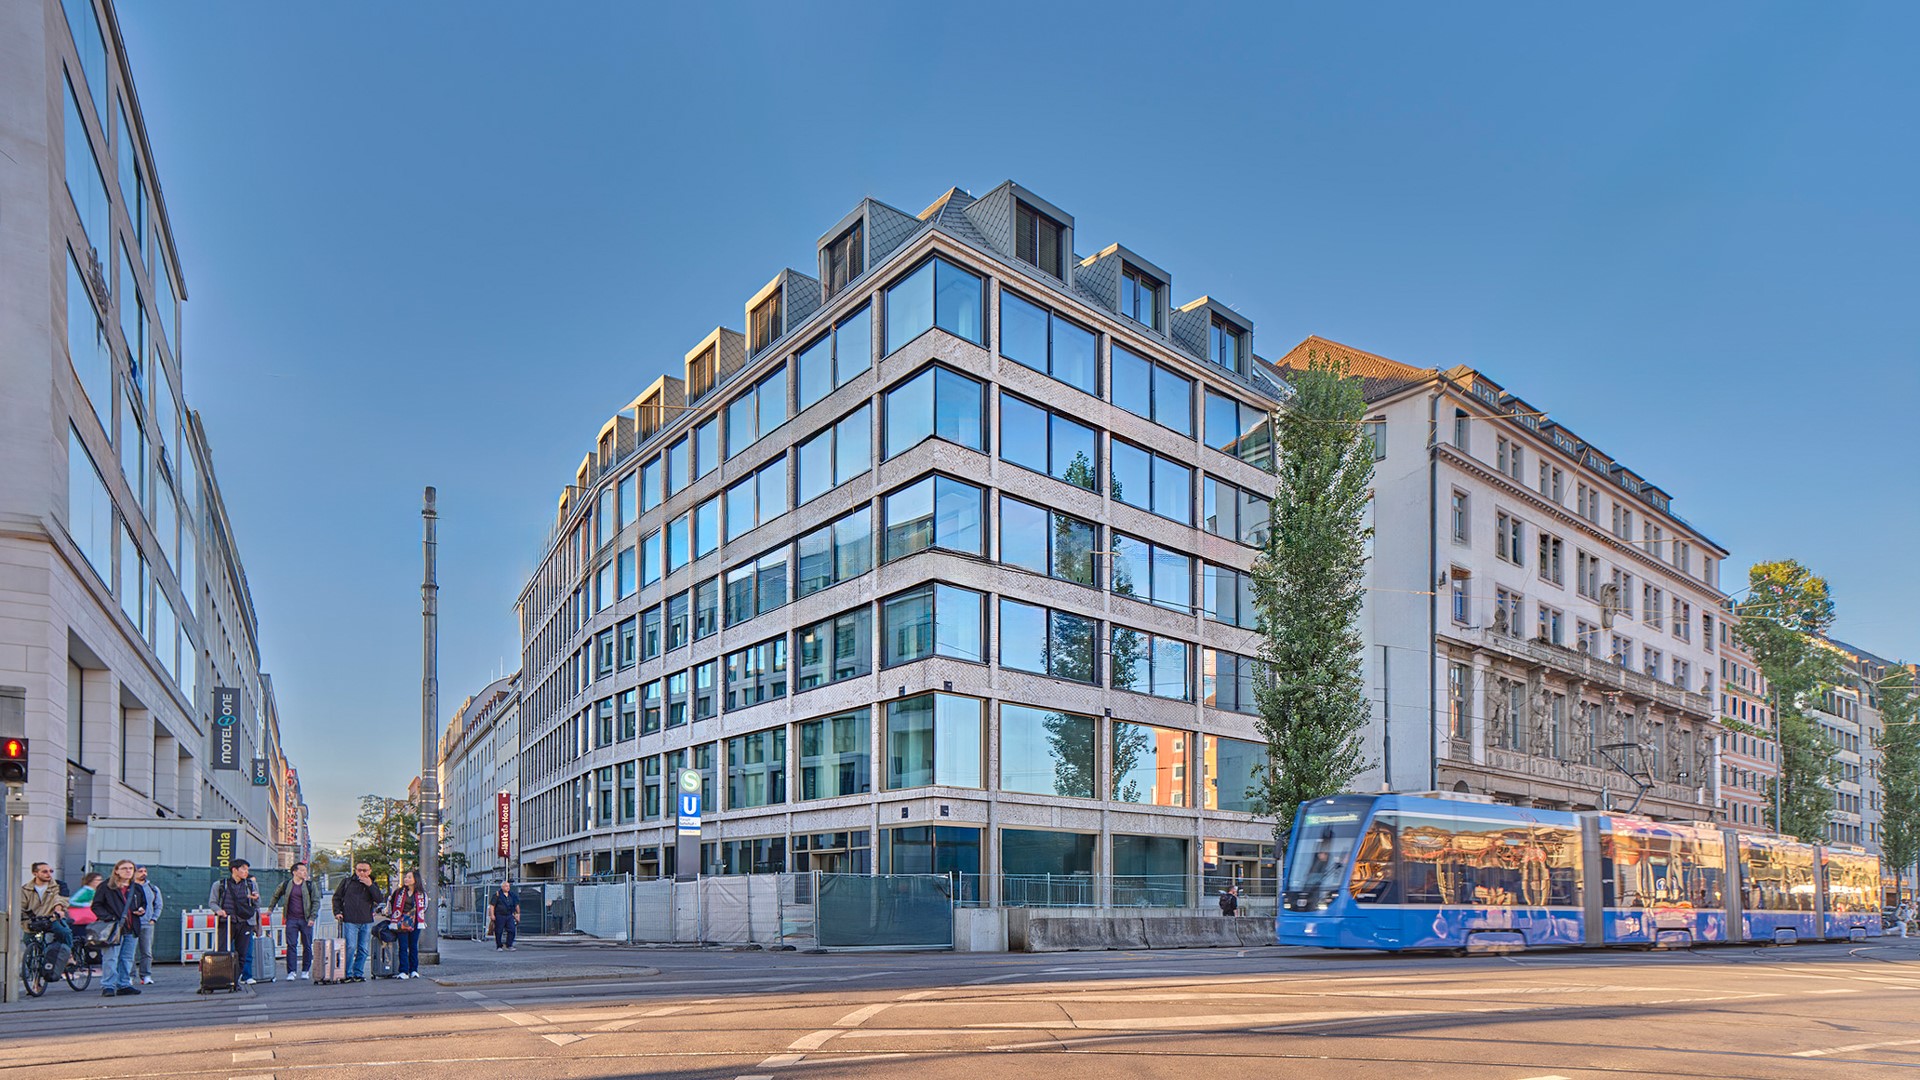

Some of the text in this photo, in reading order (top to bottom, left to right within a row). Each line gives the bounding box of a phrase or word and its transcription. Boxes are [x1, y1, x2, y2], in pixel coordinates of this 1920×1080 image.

[222, 694, 232, 764] MOTEL ONE
[683, 772, 698, 790] S
[501, 803, 509, 823] Hotel
[683, 796, 697, 815] U
[217, 832, 231, 870] plenia
